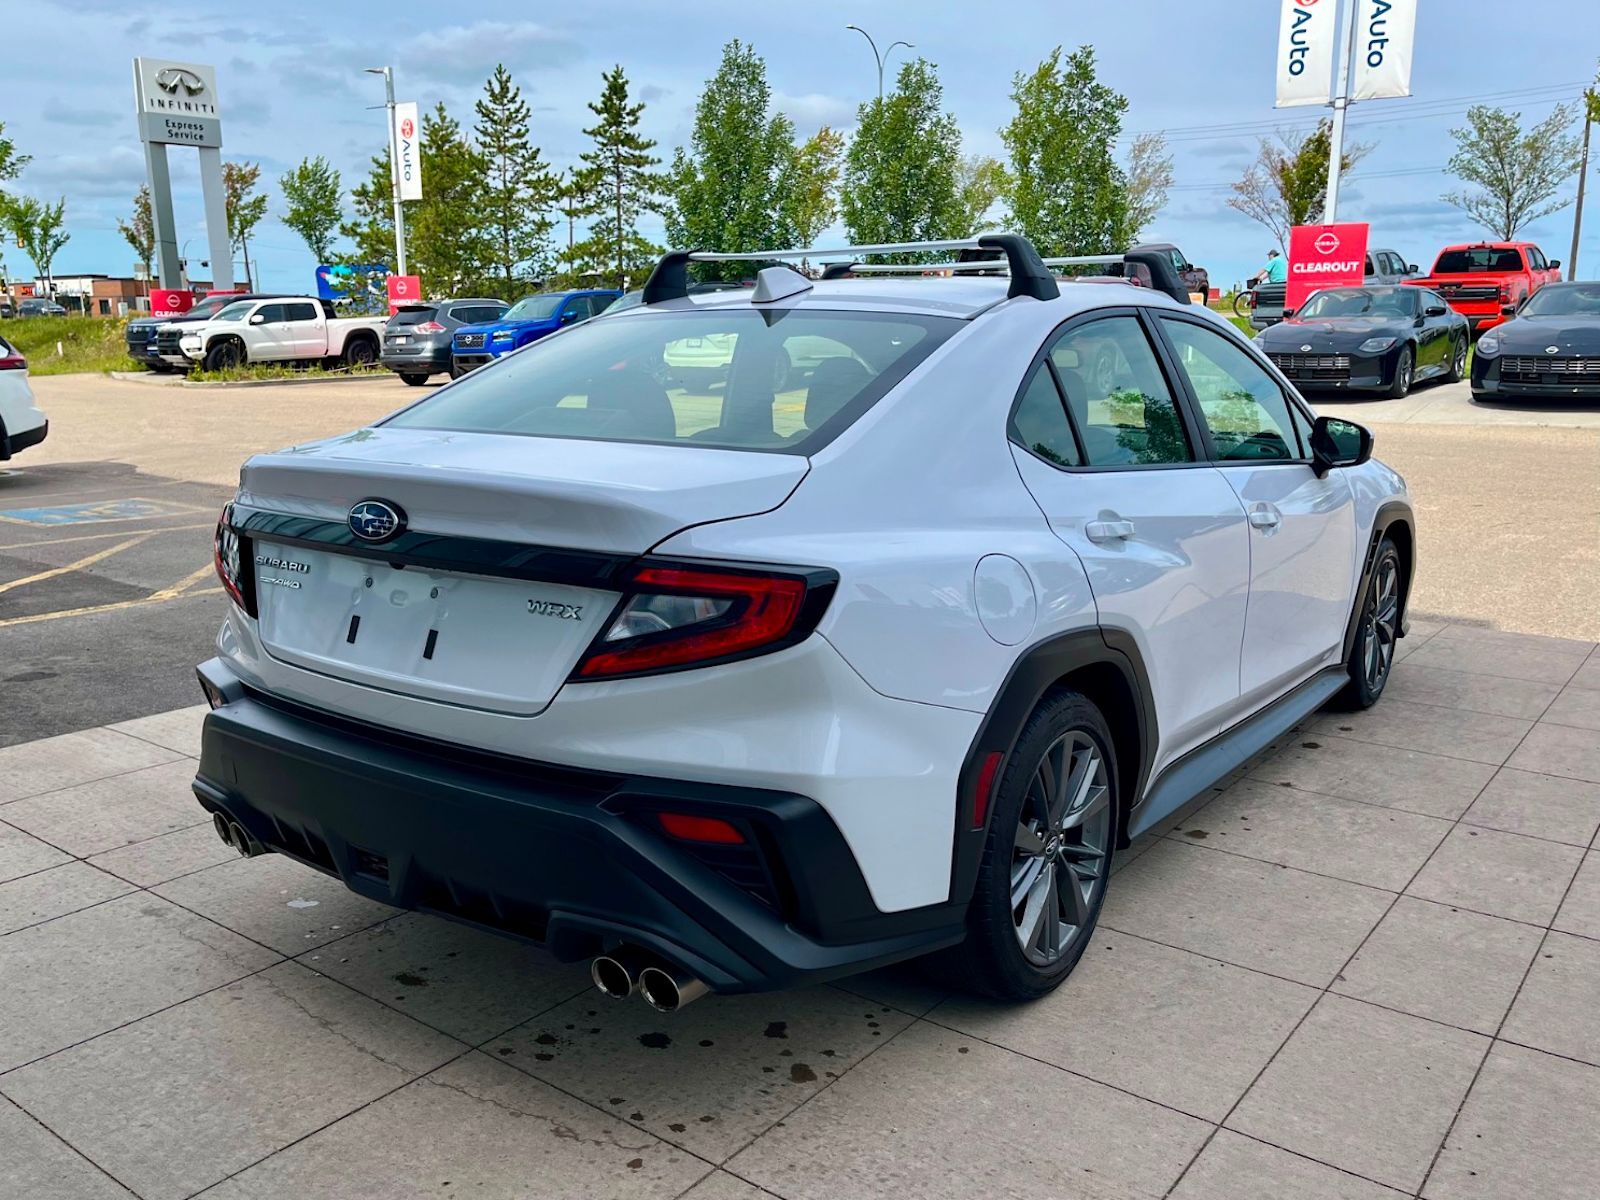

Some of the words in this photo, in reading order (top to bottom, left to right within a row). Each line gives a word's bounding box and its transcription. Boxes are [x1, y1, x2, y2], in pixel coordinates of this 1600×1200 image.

[1288, 8, 1313, 76] Auto
[1366, 0, 1392, 68] Auto
[150, 98, 215, 114] INFINITI
[165, 119, 204, 131] Express
[167, 129, 204, 141] Service
[402, 139, 412, 182] Auto
[1292, 261, 1360, 273] CLEAROUT
[255, 555, 310, 574] SUBARU
[273, 577, 302, 589] AWD
[527, 599, 583, 621] WRX
